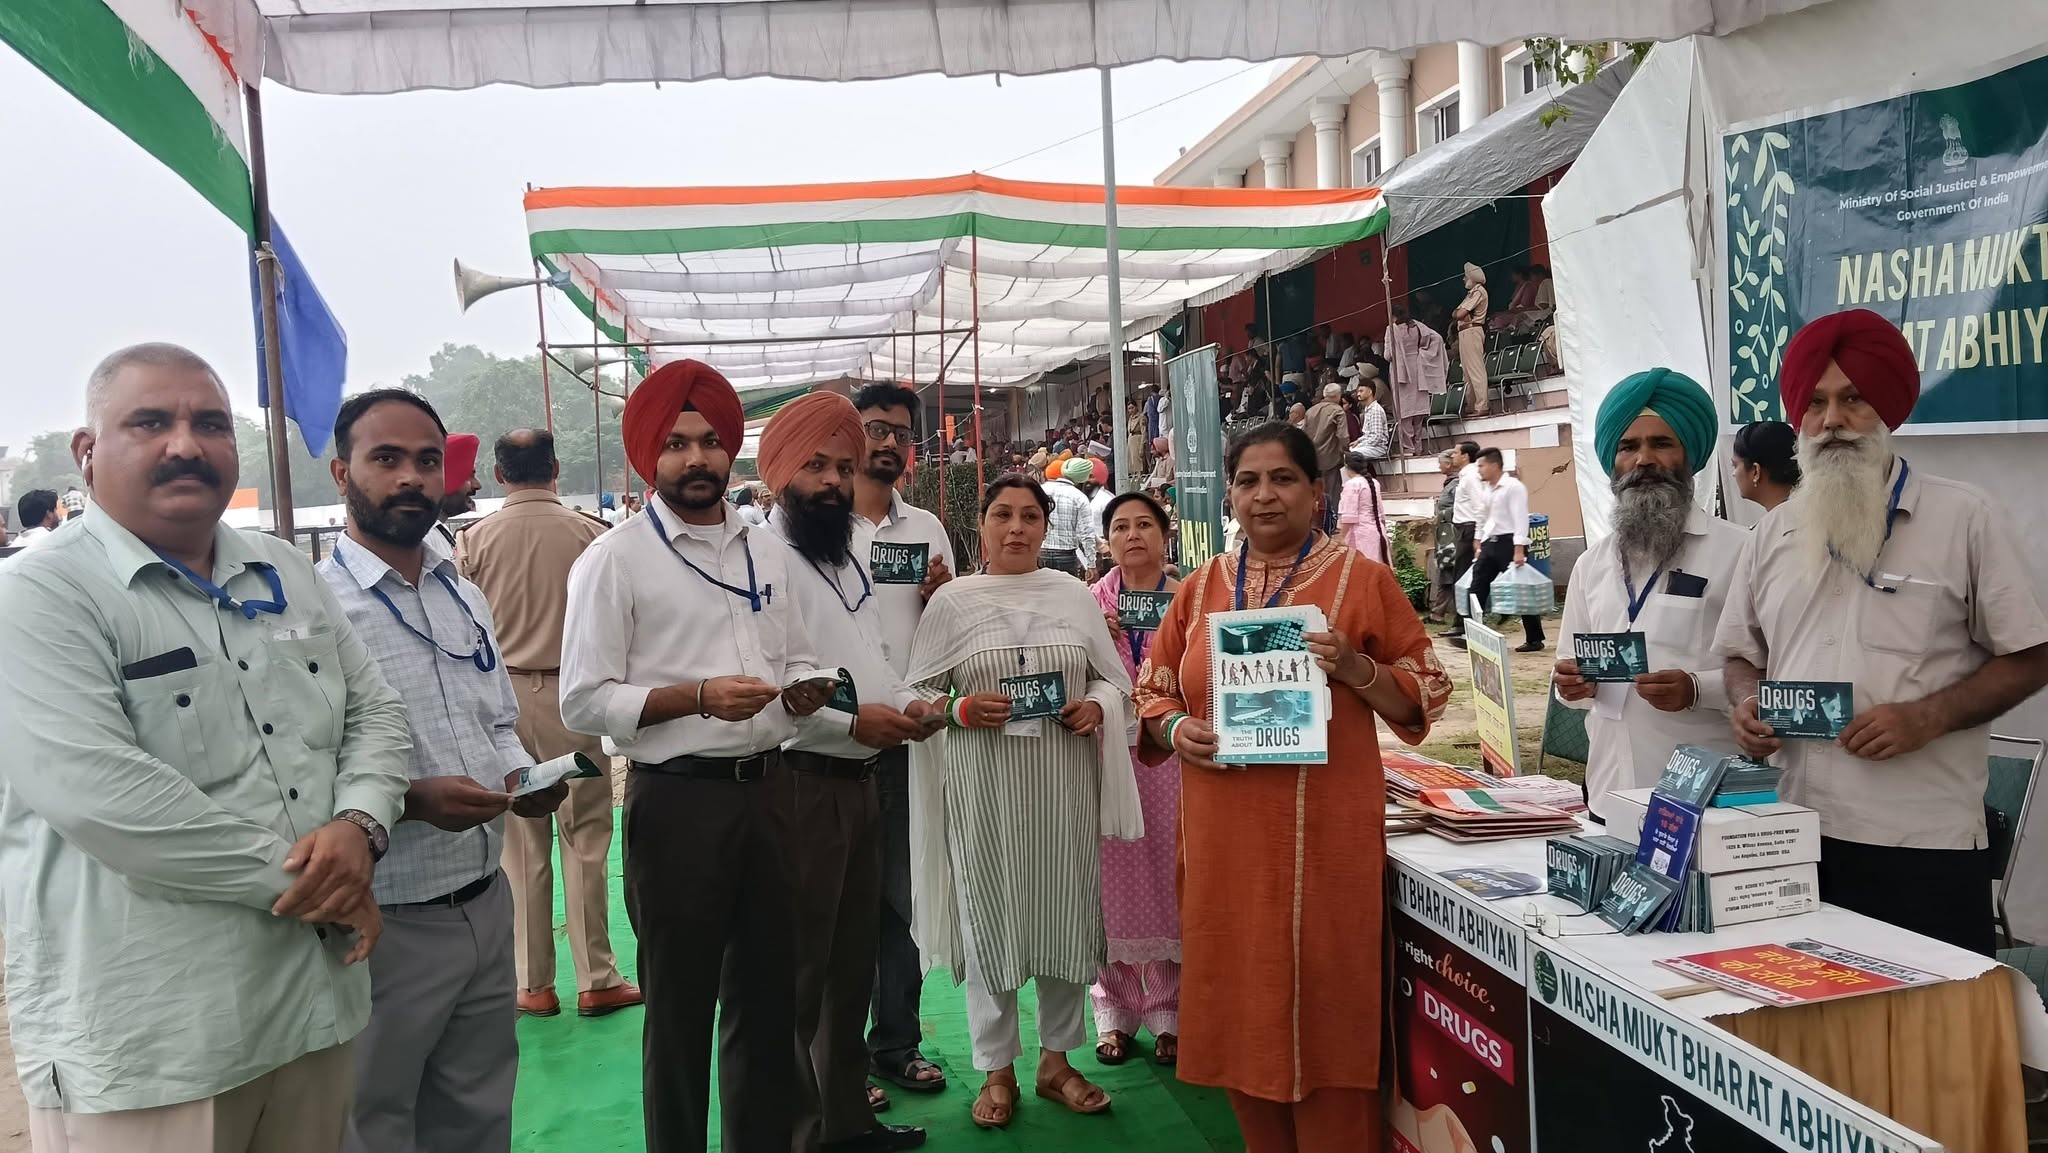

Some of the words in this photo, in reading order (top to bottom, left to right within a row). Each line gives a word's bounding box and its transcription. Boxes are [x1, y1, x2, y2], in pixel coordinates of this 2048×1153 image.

[1839, 194, 1882, 210] Ministry
[1885, 190, 1898, 203] Of
[1900, 185, 1933, 200] Social
[1935, 178, 1977, 194] Justice
[1980, 175, 1988, 187] &
[1897, 201, 1966, 221] Government
[1968, 198, 1982, 210] Of
[1983, 192, 2009, 207] India
[1837, 242, 1954, 305] NASHA
[1960, 223, 2048, 293] MUKT
[1936, 306, 2048, 371] ABHIY
[871, 545, 909, 564] DRUGS
[1119, 594, 1153, 611] DRUGS
[1574, 638, 1616, 658] DRUGS
[1001, 680, 1040, 699] DRUGS
[1761, 686, 1815, 710] DRUGS
[1256, 726, 1300, 747] DRUGS
[1667, 750, 1700, 778] DRUGS
[1548, 845, 1578, 875] DRUGS
[1612, 872, 1647, 904] DRUGS
[1410, 877, 1455, 934] BHARAT
[1458, 905, 1518, 972] ABHIYAN
[1405, 941, 1434, 969] right
[1436, 953, 1496, 1013] choice,
[1424, 991, 1503, 1069] DRUGS
[1561, 968, 1621, 1039] NASHA
[1622, 1001, 1678, 1071] MUKT
[1682, 1033, 1773, 1127] BHARAT
[1779, 1089, 1899, 1153] ABHIY
